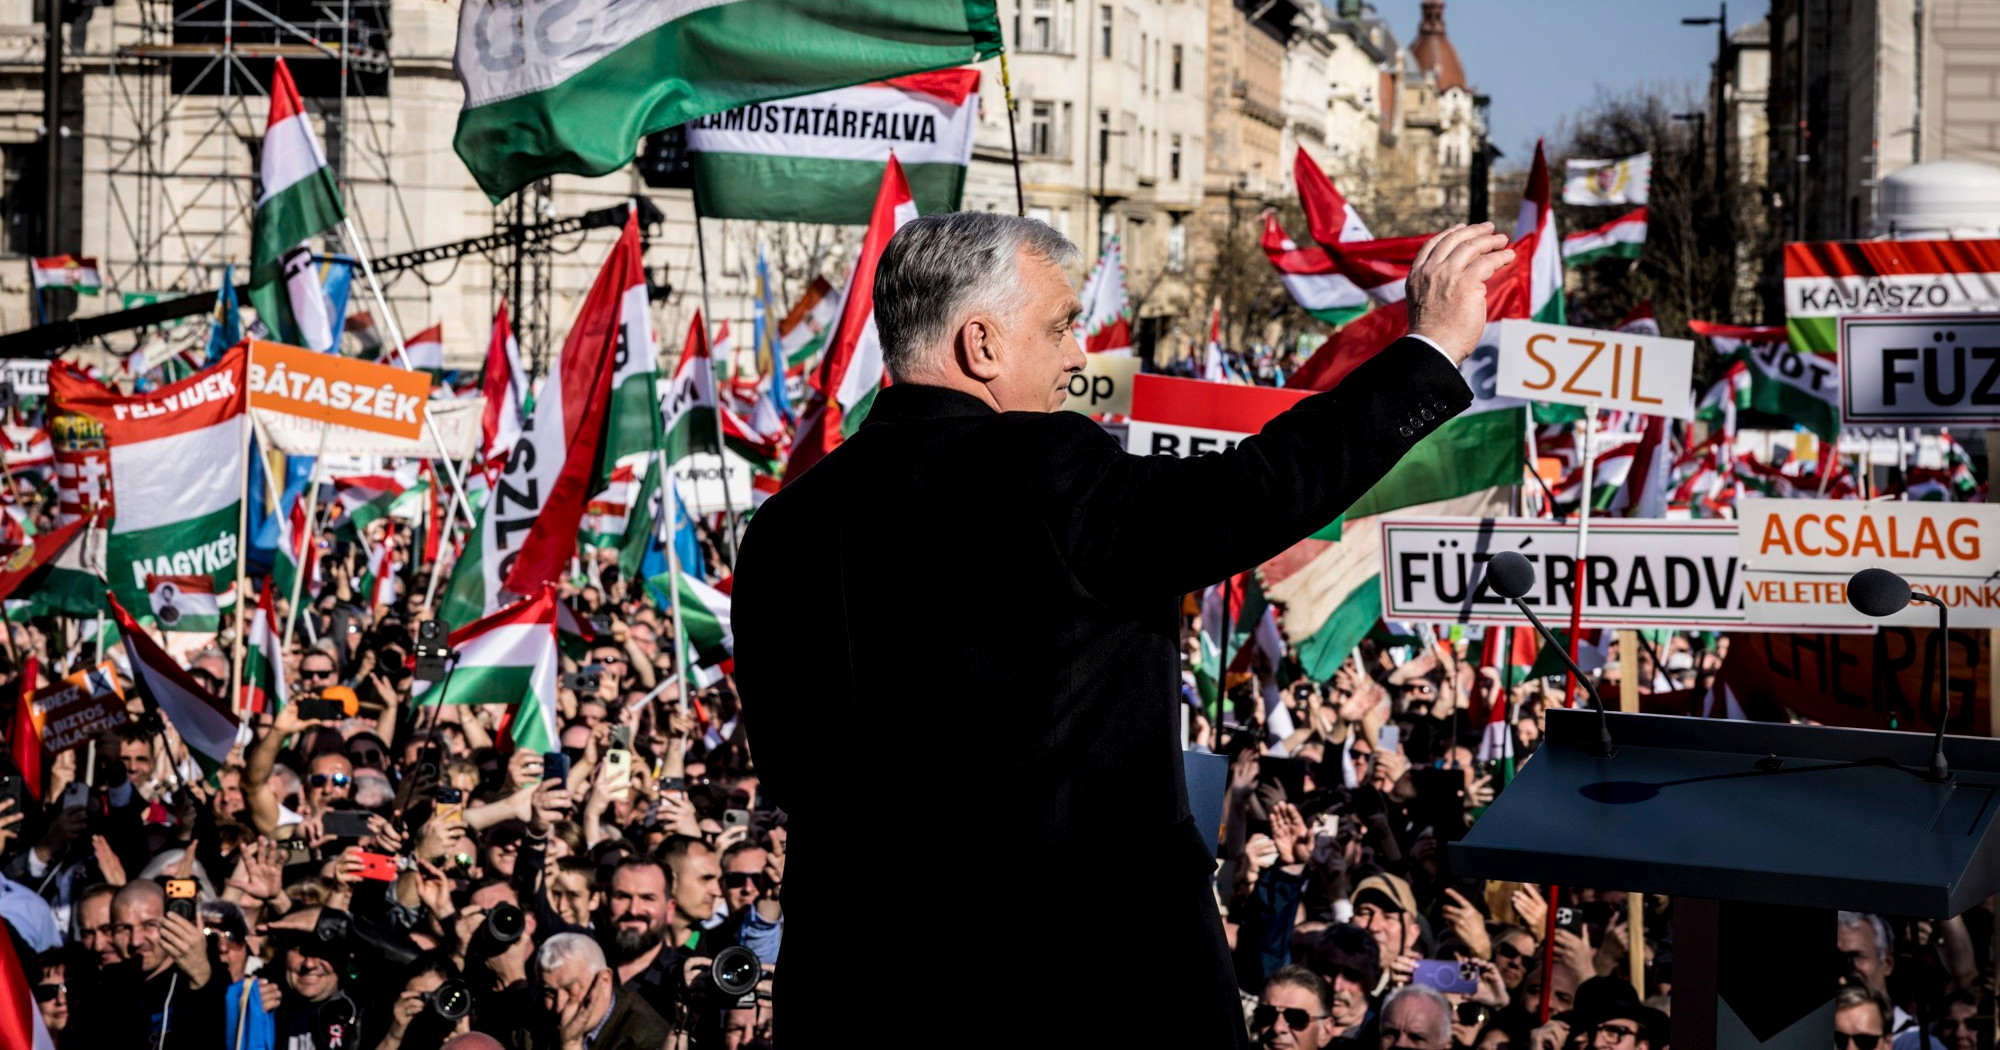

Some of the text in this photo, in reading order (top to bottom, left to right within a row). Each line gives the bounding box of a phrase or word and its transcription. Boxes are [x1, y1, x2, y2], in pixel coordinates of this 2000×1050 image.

[1800, 277, 1949, 310] KAJÁSZÓ
[249, 361, 421, 424] BÁTASZÉK
[1067, 373, 1115, 406] op
[1522, 333, 1663, 405] SZIL
[1760, 512, 1981, 561] ACSALAG
[1399, 536, 1744, 610] FÜZÉRRADV
